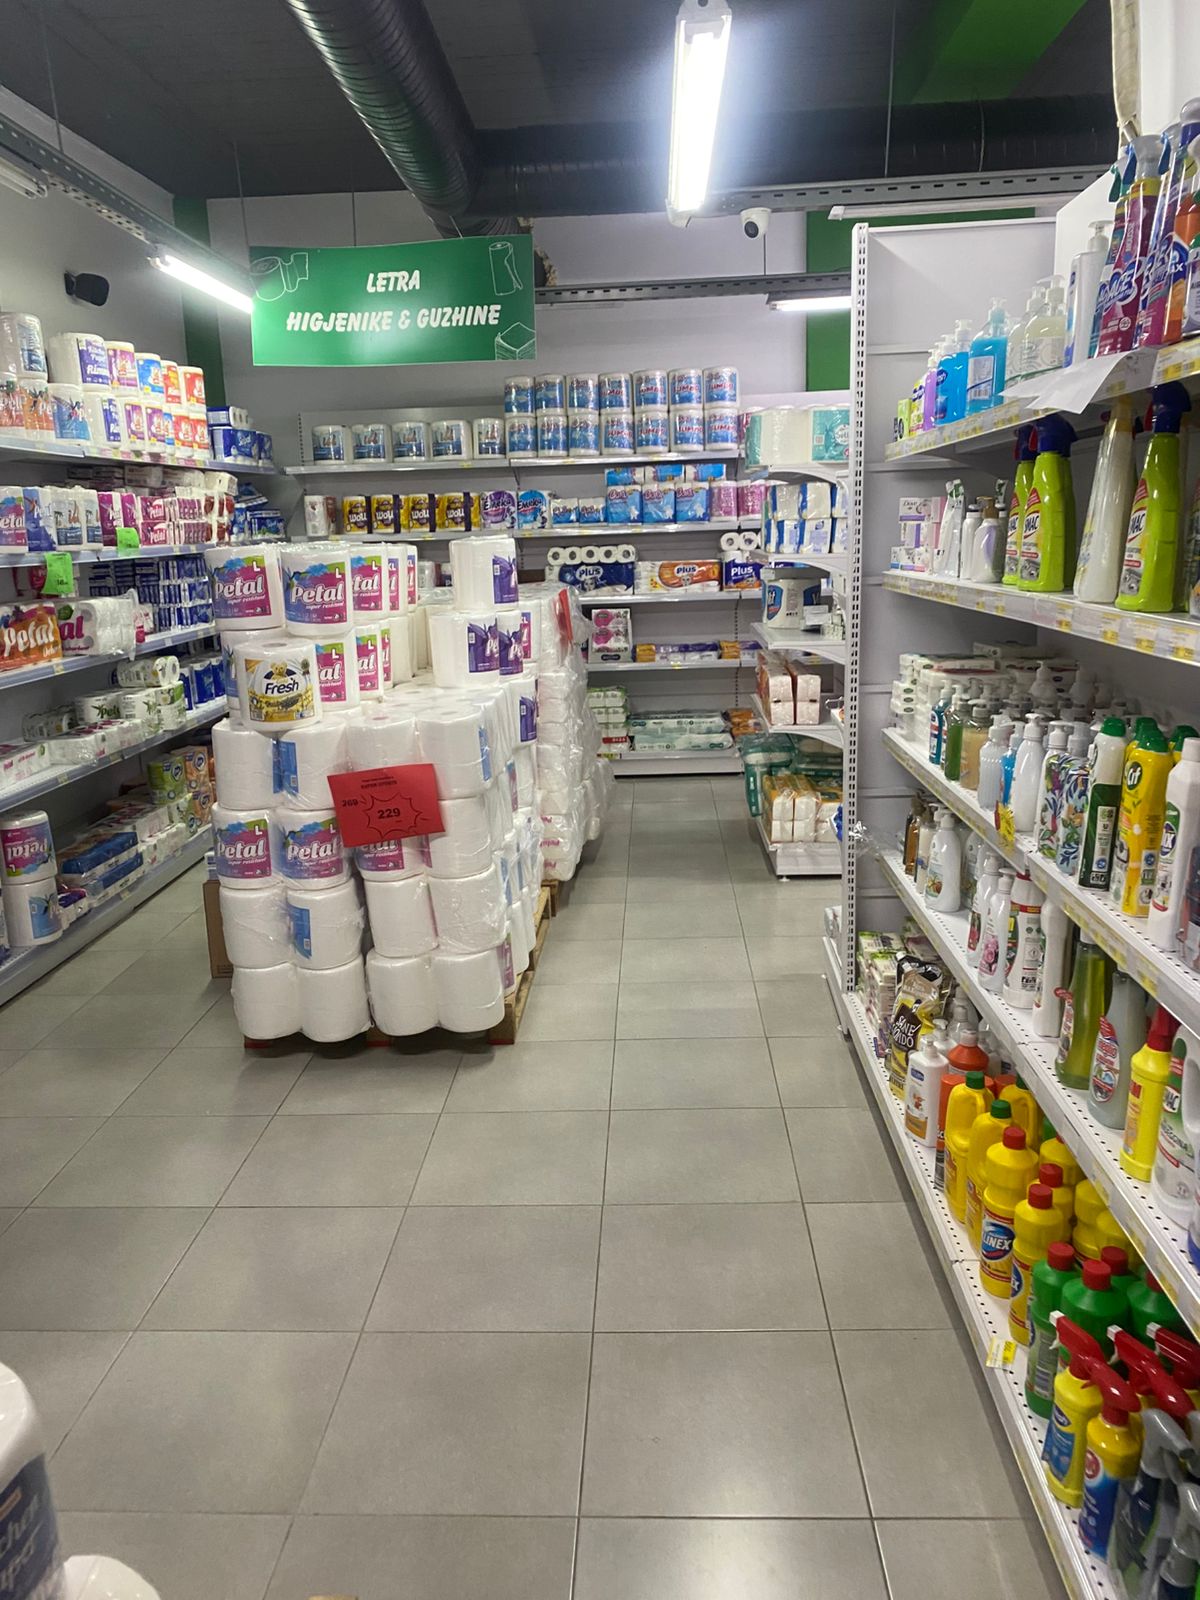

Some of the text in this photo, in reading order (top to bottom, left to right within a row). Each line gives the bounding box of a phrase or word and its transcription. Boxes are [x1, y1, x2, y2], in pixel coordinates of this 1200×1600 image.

[366, 270, 421, 293] LETRA
[286, 304, 501, 333] HIGJENIKE & GUZHINE
[1, 514, 24, 528] etal
[252, 561, 260, 572] L
[335, 567, 342, 578] L
[372, 560, 378, 571] L
[215, 576, 263, 599] Petal
[291, 583, 343, 603] Petal
[2, 616, 55, 658] Petal
[368, 640, 374, 649] L
[332, 649, 339, 659] L
[265, 677, 299, 695] Fresh
[377, 807, 400, 819] 229
[255, 825, 262, 835] L
[329, 823, 336, 833] L
[217, 840, 265, 859] Petal
[288, 837, 338, 860] Petal
